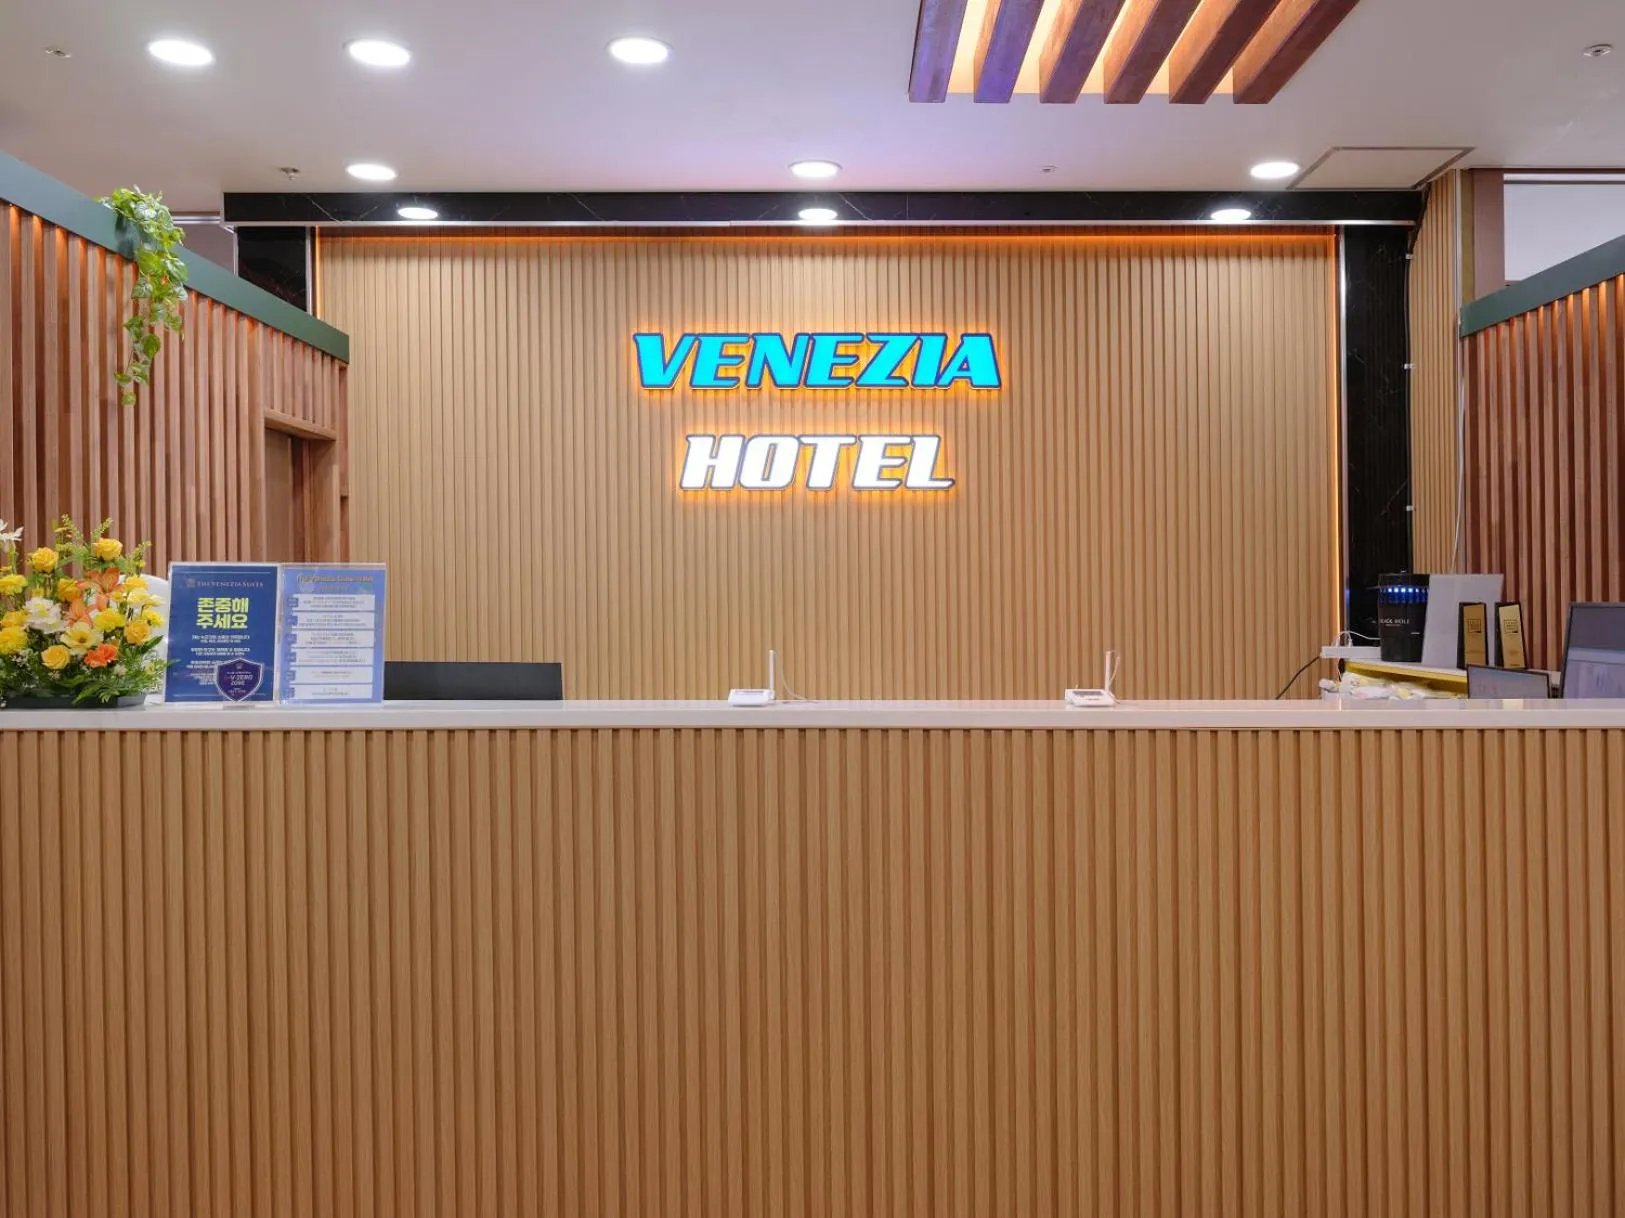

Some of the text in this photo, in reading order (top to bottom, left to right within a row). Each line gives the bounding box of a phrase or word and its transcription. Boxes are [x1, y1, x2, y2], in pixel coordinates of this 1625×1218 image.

[632, 332, 1003, 389] VENEZIA
[678, 433, 957, 491] HOTEL
[196, 613, 248, 630] 주세요
[197, 597, 249, 613] 존중해
